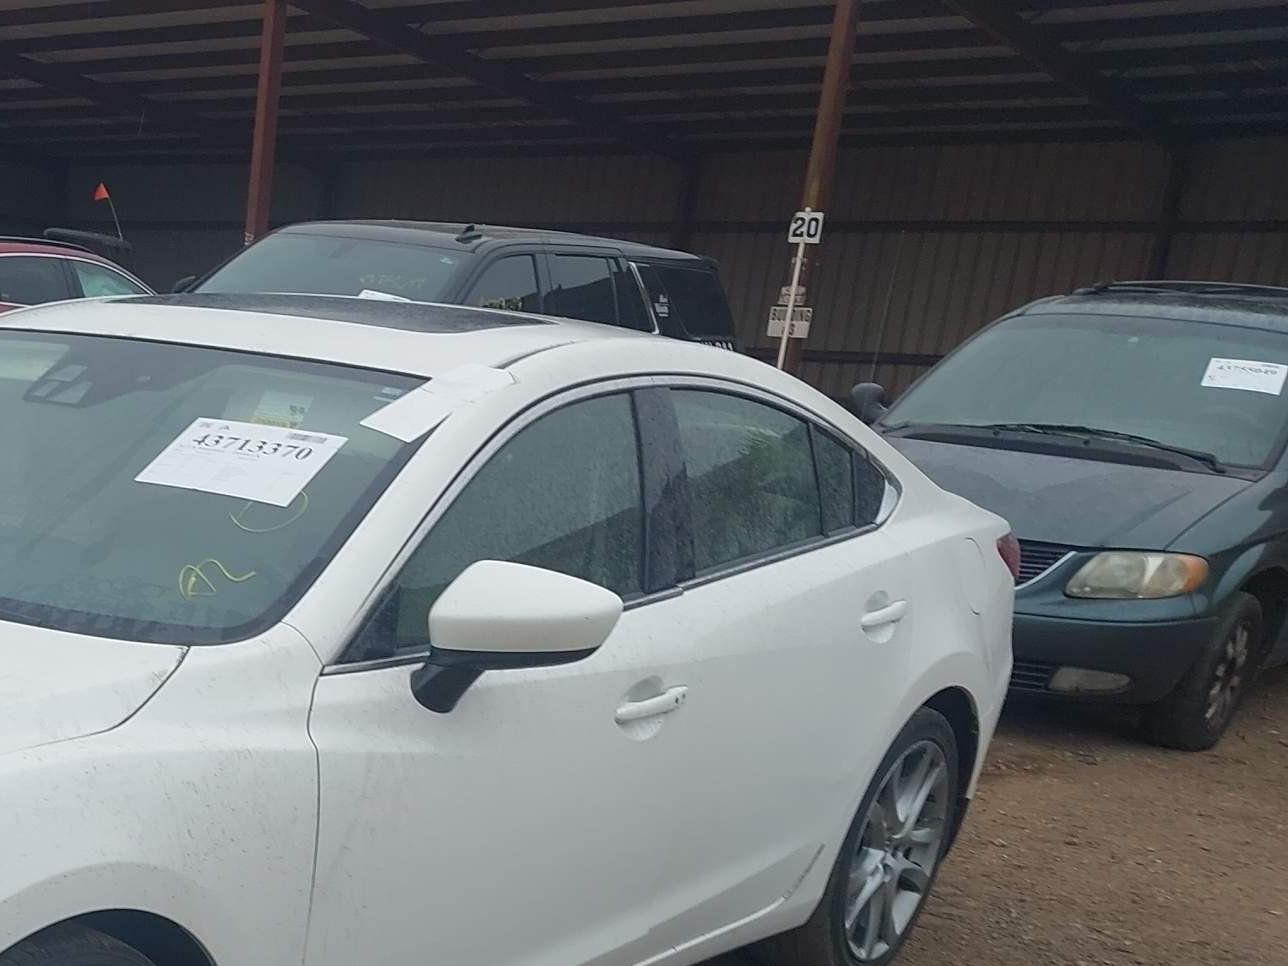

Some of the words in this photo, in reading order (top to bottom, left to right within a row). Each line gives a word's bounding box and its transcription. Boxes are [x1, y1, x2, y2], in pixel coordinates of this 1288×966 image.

[792, 217, 819, 238] 20
[771, 308, 811, 322] BUIDING
[192, 433, 313, 461] 43713370
